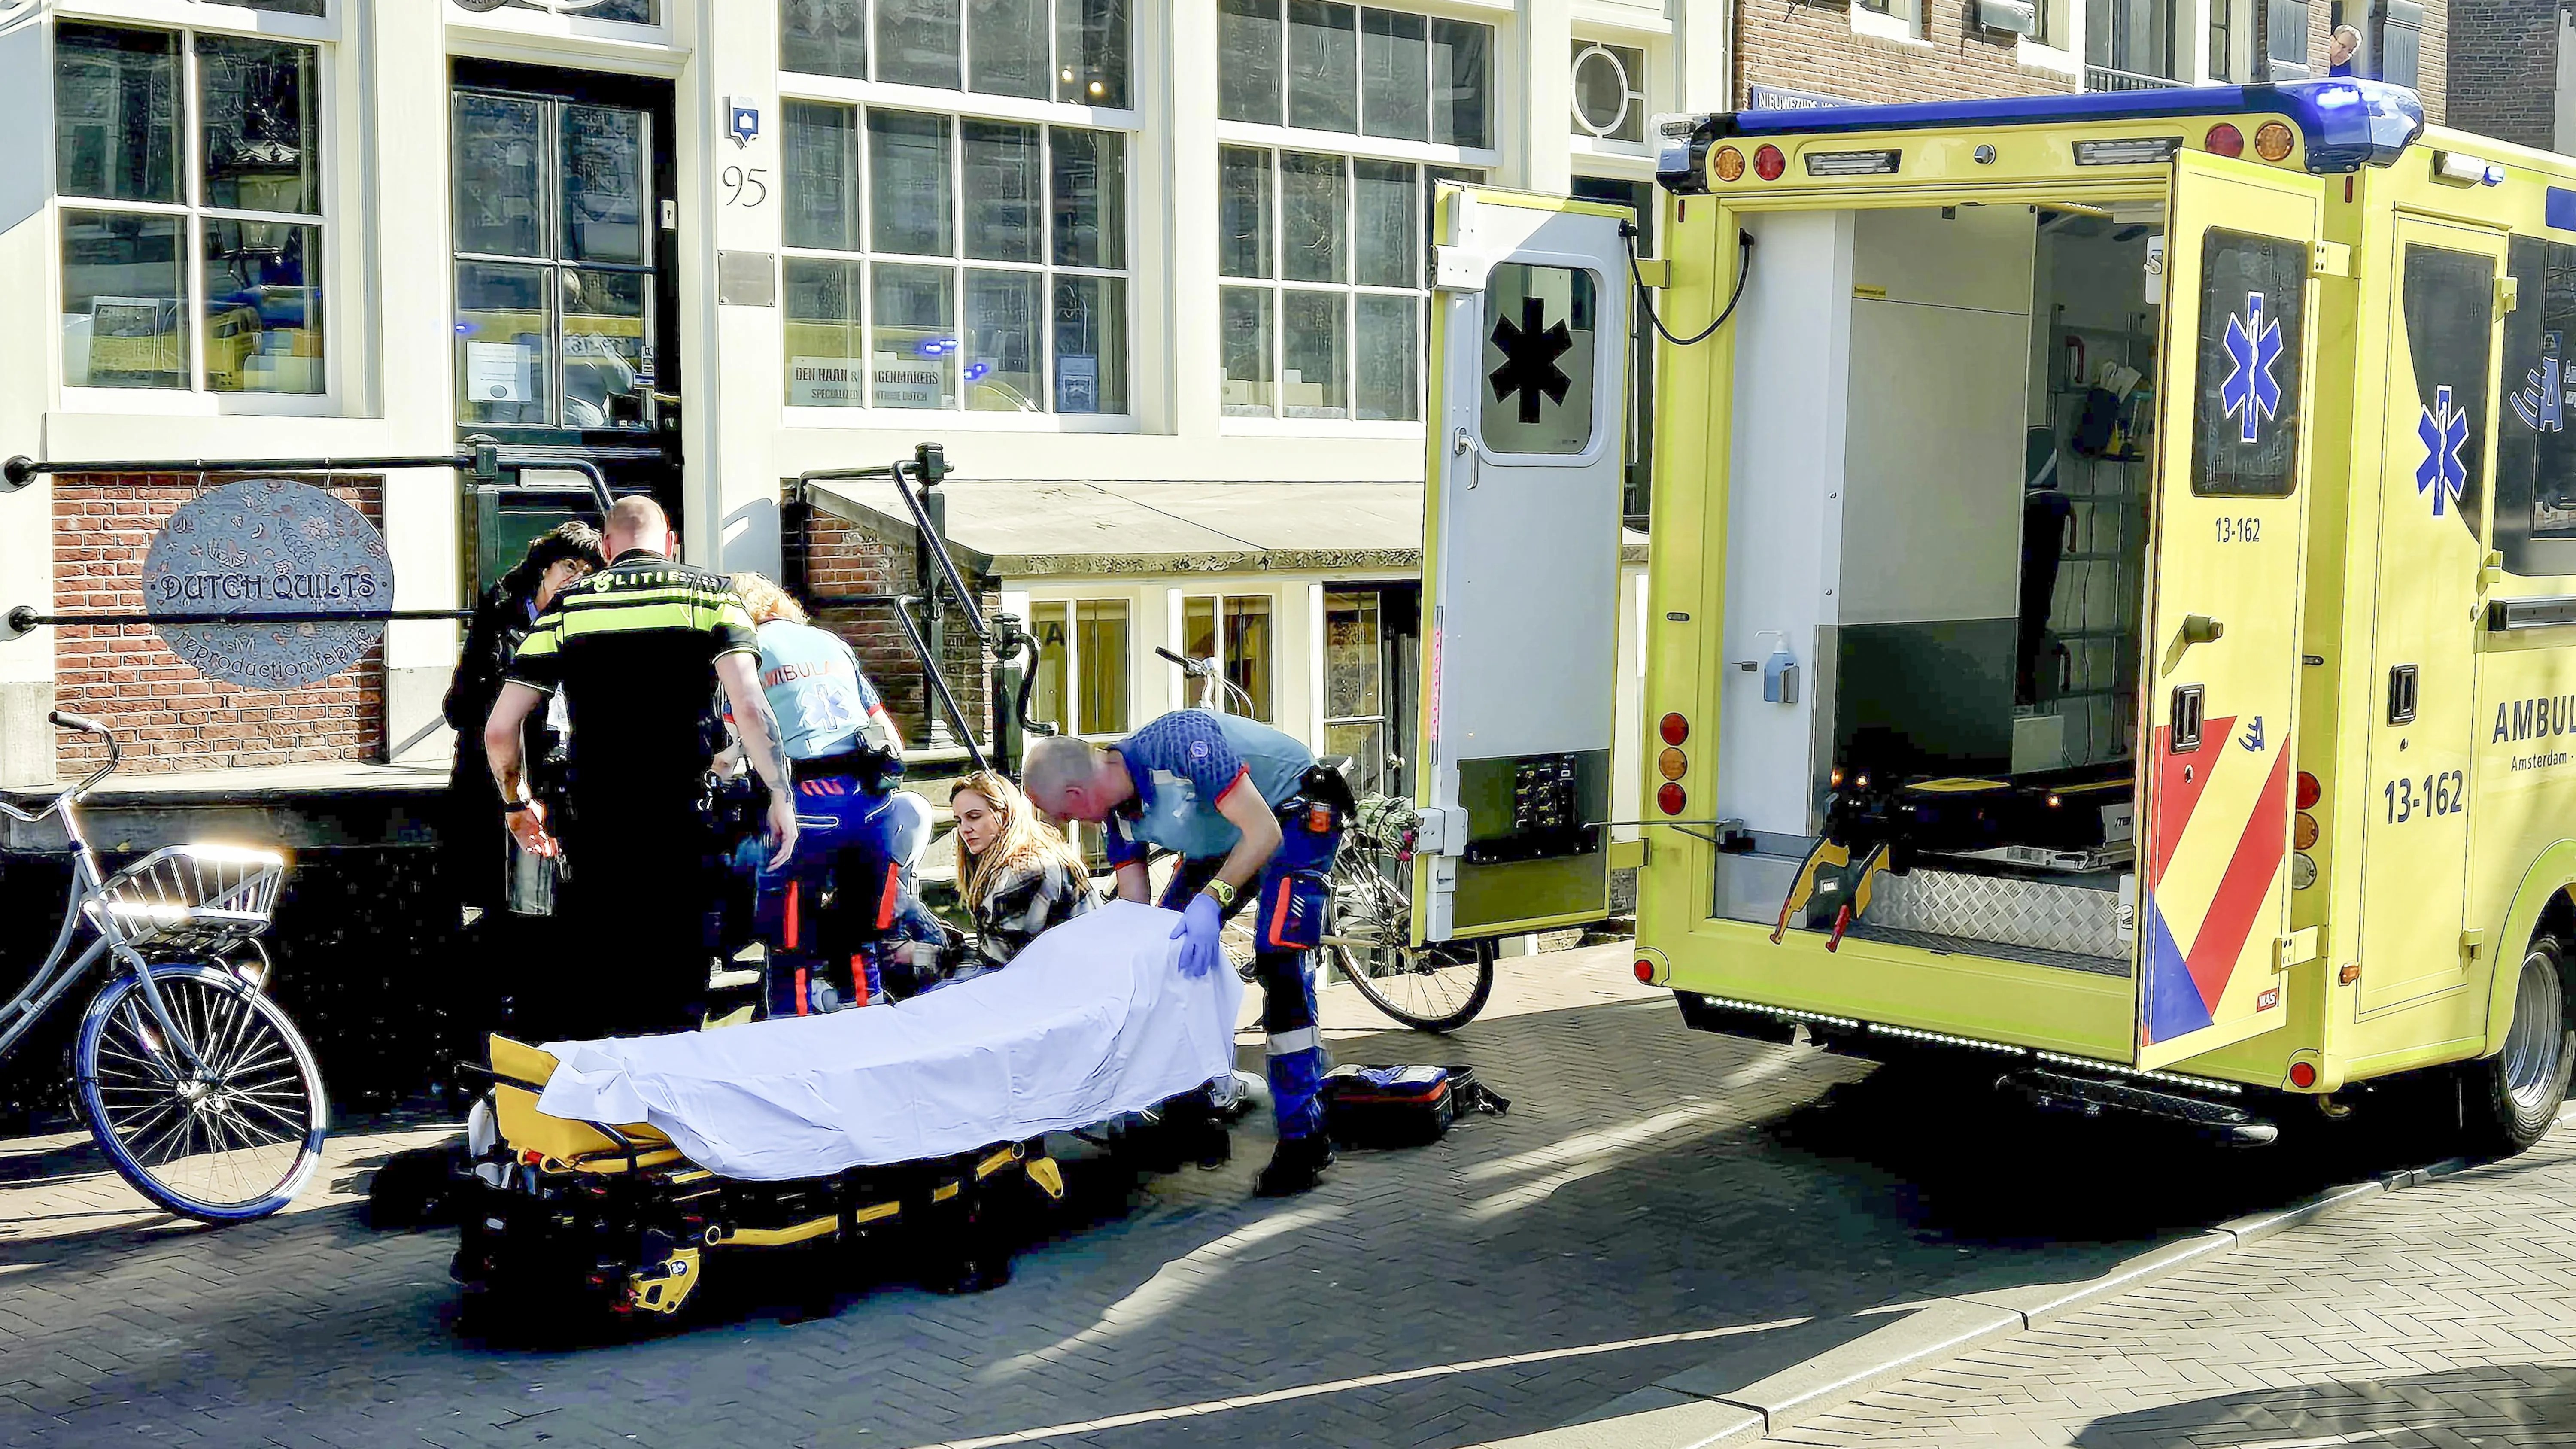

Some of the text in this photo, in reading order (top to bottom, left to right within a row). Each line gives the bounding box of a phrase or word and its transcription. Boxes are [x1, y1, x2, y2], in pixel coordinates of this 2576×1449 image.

[722, 166, 767, 207] 95
[796, 367, 815, 381] DEN
[874, 370, 939, 384] GENMAKERS
[2215, 517, 2260, 542] 13-162
[161, 573, 376, 600] DUTCH QUILTS
[173, 629, 310, 678] reproduction
[2492, 694, 2576, 744] AMBUL
[2511, 748, 2567, 772] Amsterdam
[2384, 769, 2464, 824] 13-162
